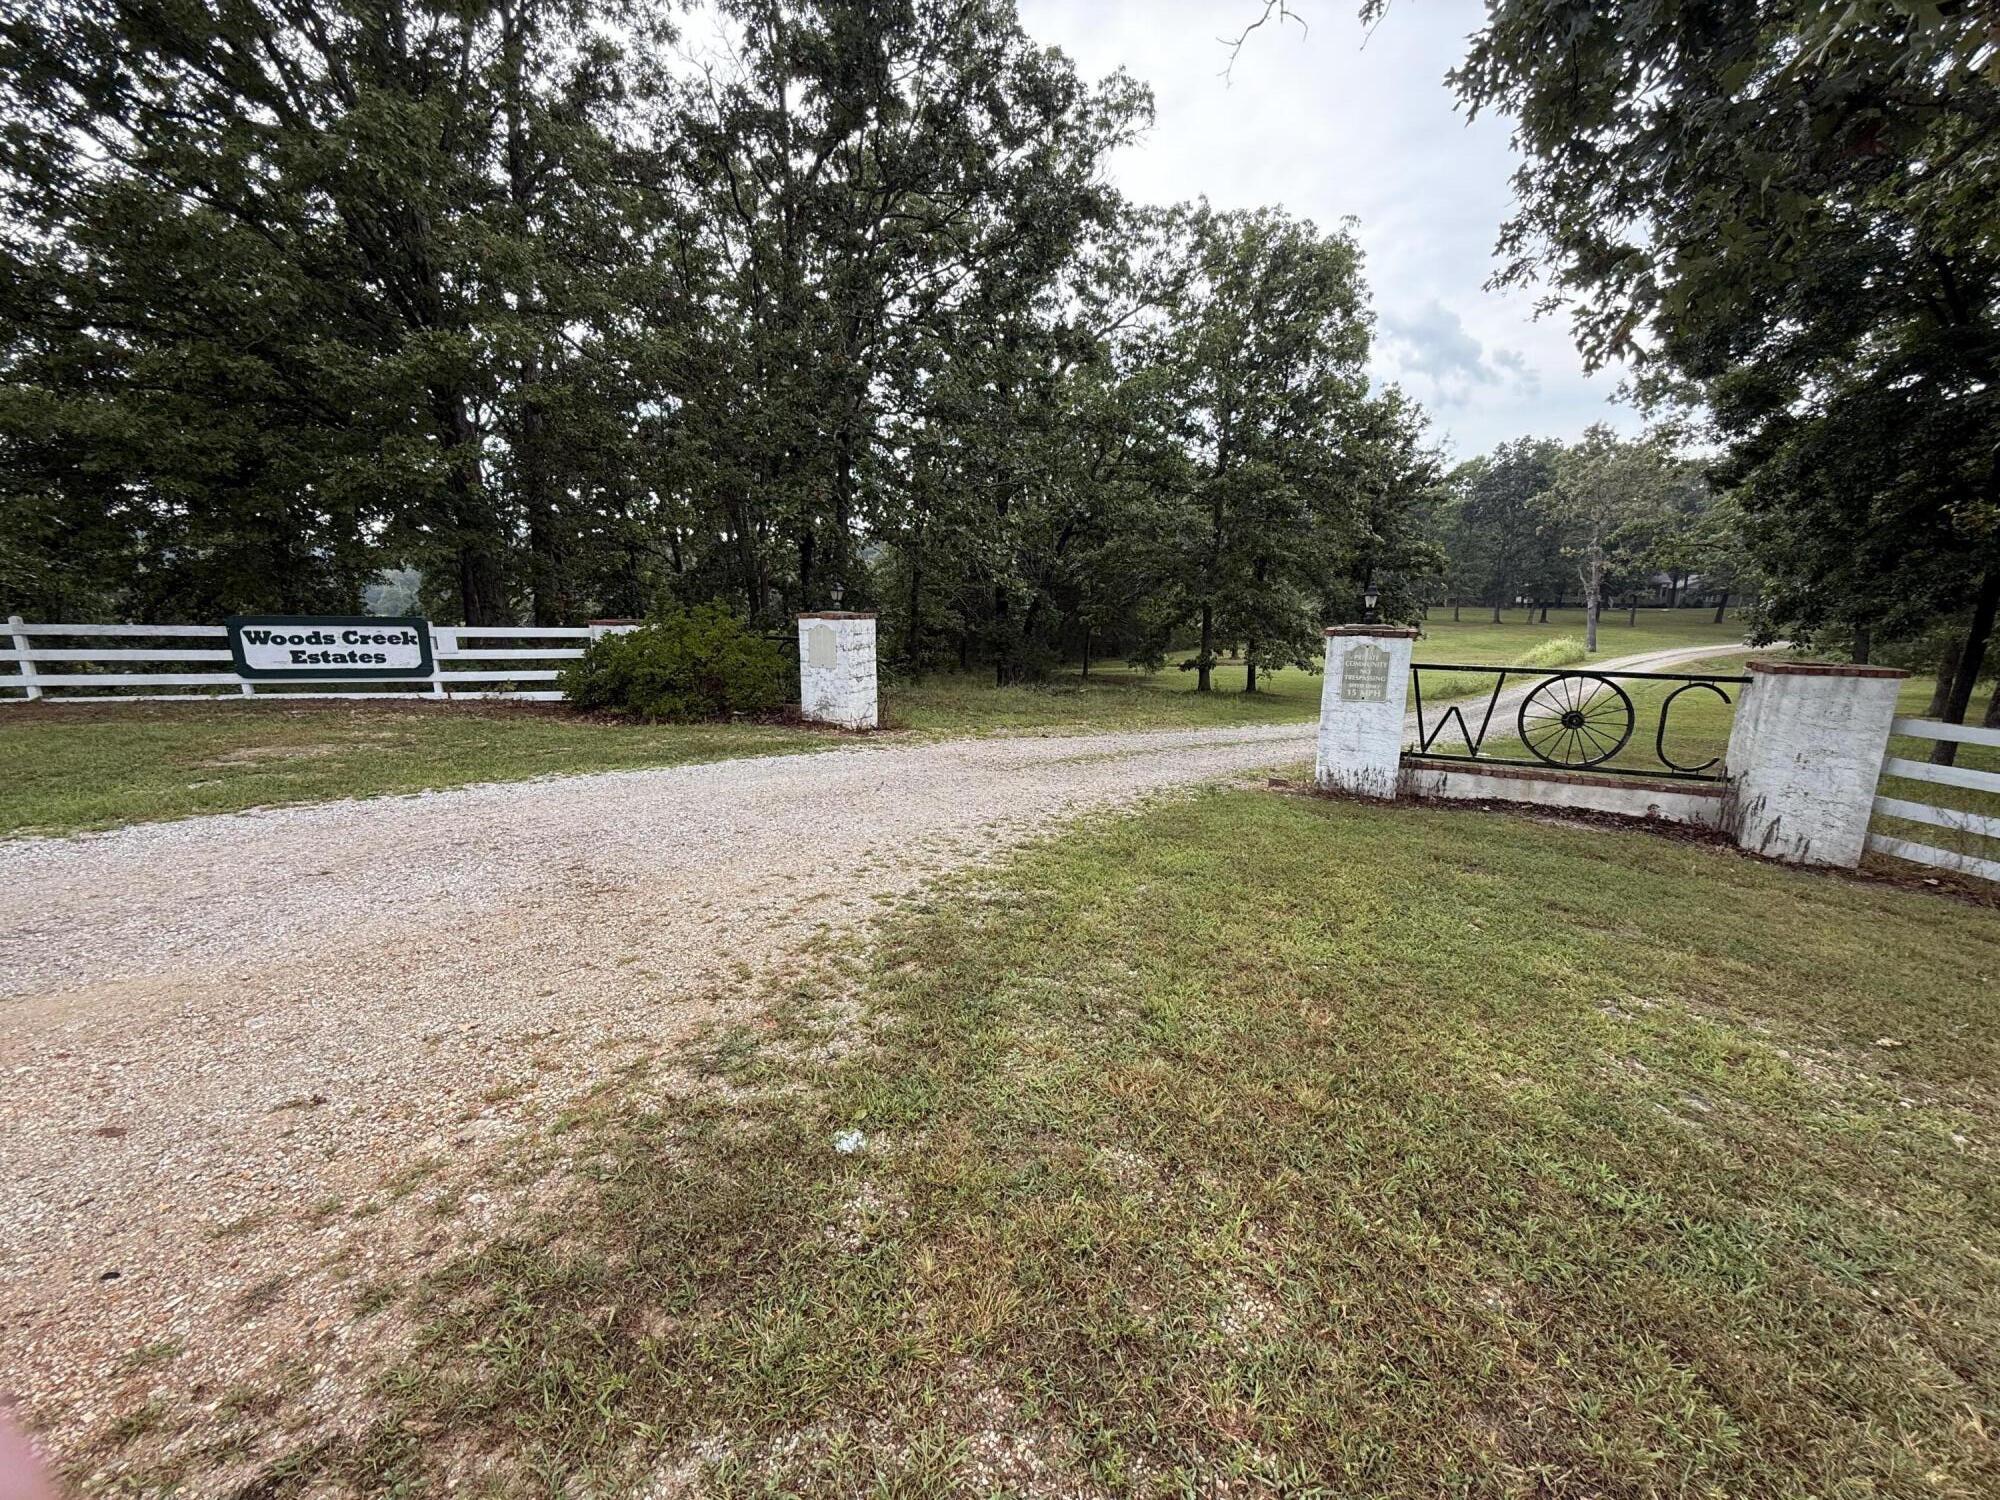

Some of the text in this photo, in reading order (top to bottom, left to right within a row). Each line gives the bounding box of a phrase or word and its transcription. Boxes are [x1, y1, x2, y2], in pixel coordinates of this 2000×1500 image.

[242, 630, 418, 646] Woods Creek
[290, 650, 387, 665] Estates
[1347, 689, 1381, 697] 15 MPH
